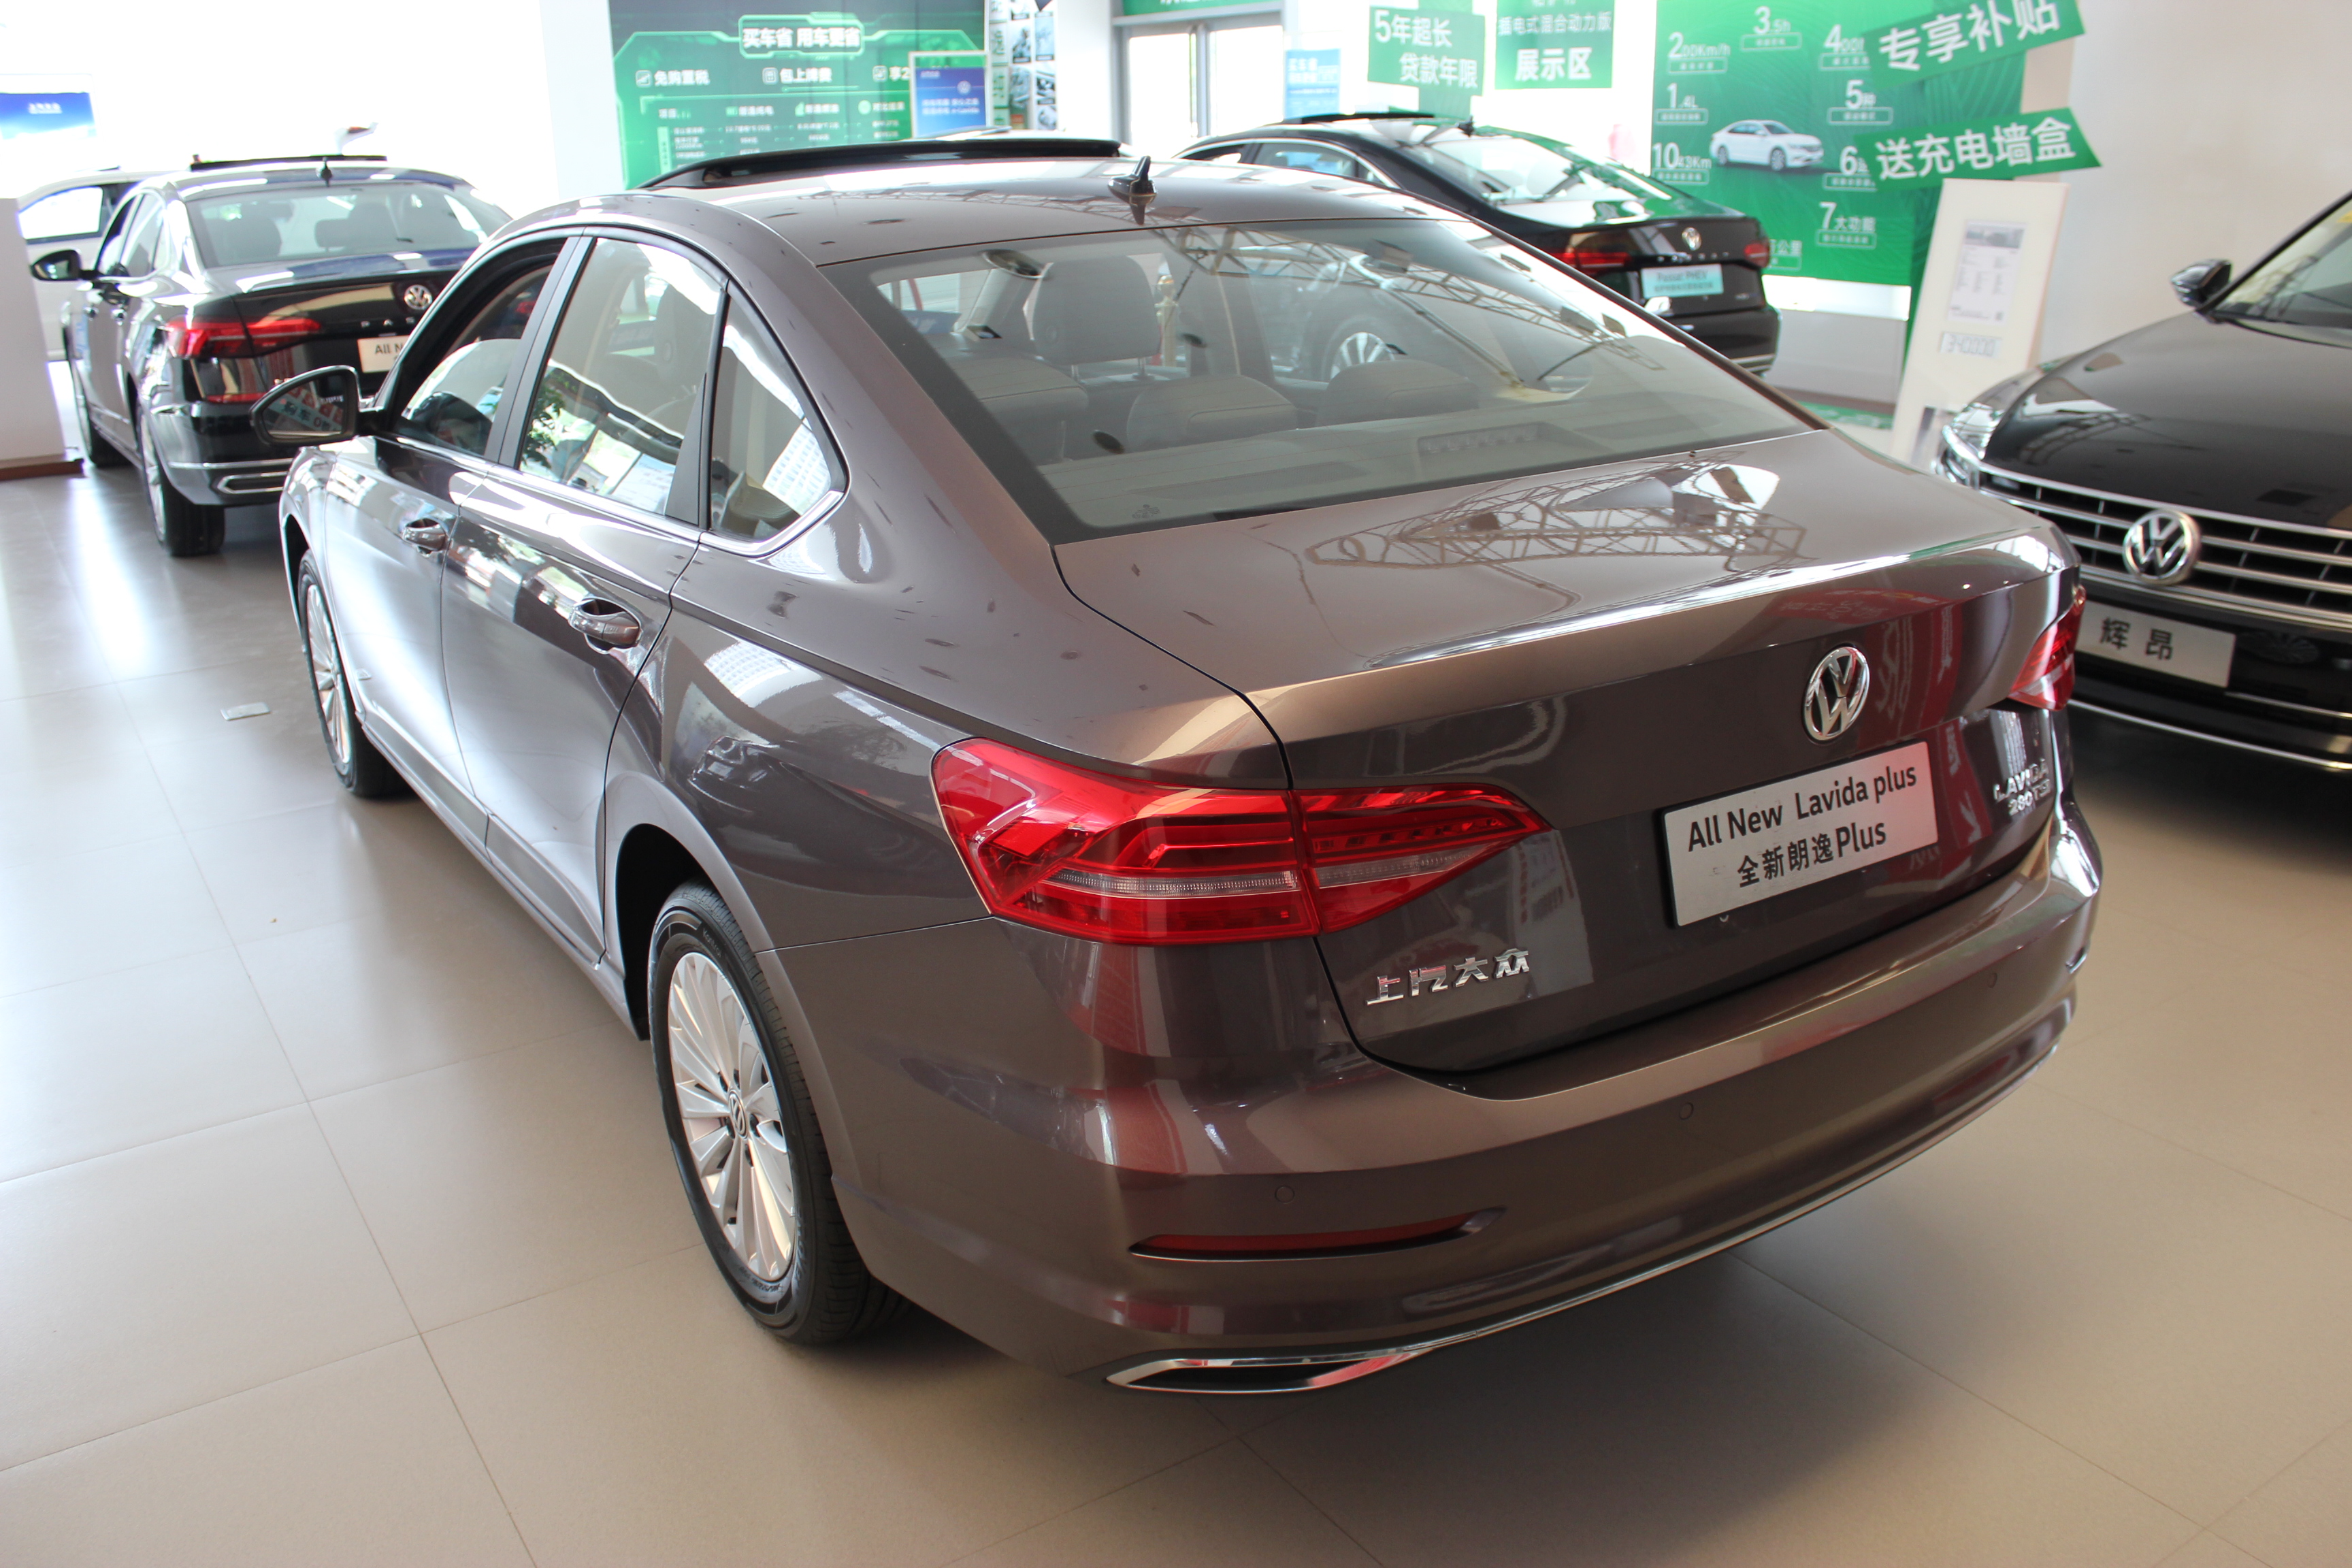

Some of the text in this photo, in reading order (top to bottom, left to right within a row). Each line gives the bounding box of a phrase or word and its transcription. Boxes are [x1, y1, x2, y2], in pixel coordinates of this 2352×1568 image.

[742, 27, 861, 48] 买车省 用车更省
[1375, 10, 1452, 48] 5年超长
[1879, 0, 2060, 71] 专享补贴
[1399, 52, 1478, 89] 贷款年限
[1515, 47, 1592, 82] 展示区
[1875, 116, 2076, 180] 送充电墙盒
[1819, 201, 1876, 231] 7大功能
[375, 344, 391, 354] All
[2100, 617, 2173, 660] 辉昂
[1688, 766, 1917, 851] All New Lavida plus
[1737, 821, 1886, 887] 全新朗逸Plus
[1365, 948, 1529, 1005] 上汽大众
